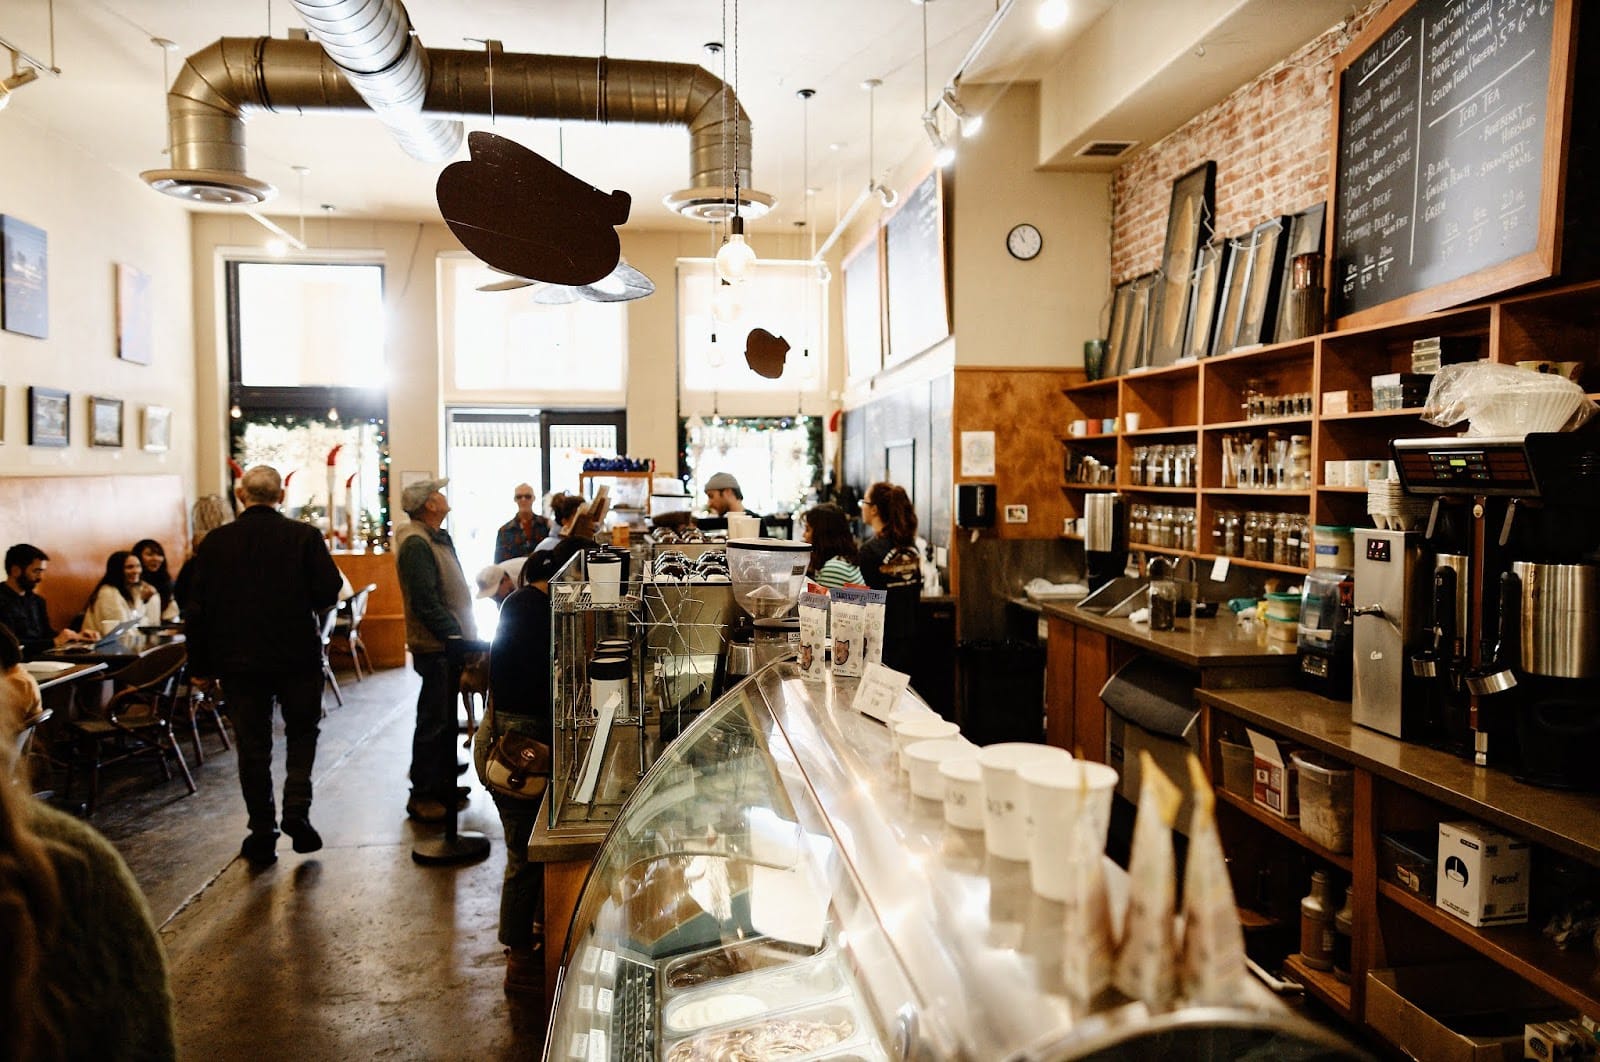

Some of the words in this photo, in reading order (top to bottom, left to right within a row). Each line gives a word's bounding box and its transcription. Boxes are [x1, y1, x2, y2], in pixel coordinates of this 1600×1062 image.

[1448, 2, 1464, 24] CHAI
[1449, 25, 1464, 46] CHAI
[1362, 48, 1379, 75] CHAI
[1381, 26, 1405, 57] LATTES
[1451, 45, 1465, 65] CHAI
[1458, 102, 1478, 128] ICED
[1481, 87, 1500, 113] TEA
